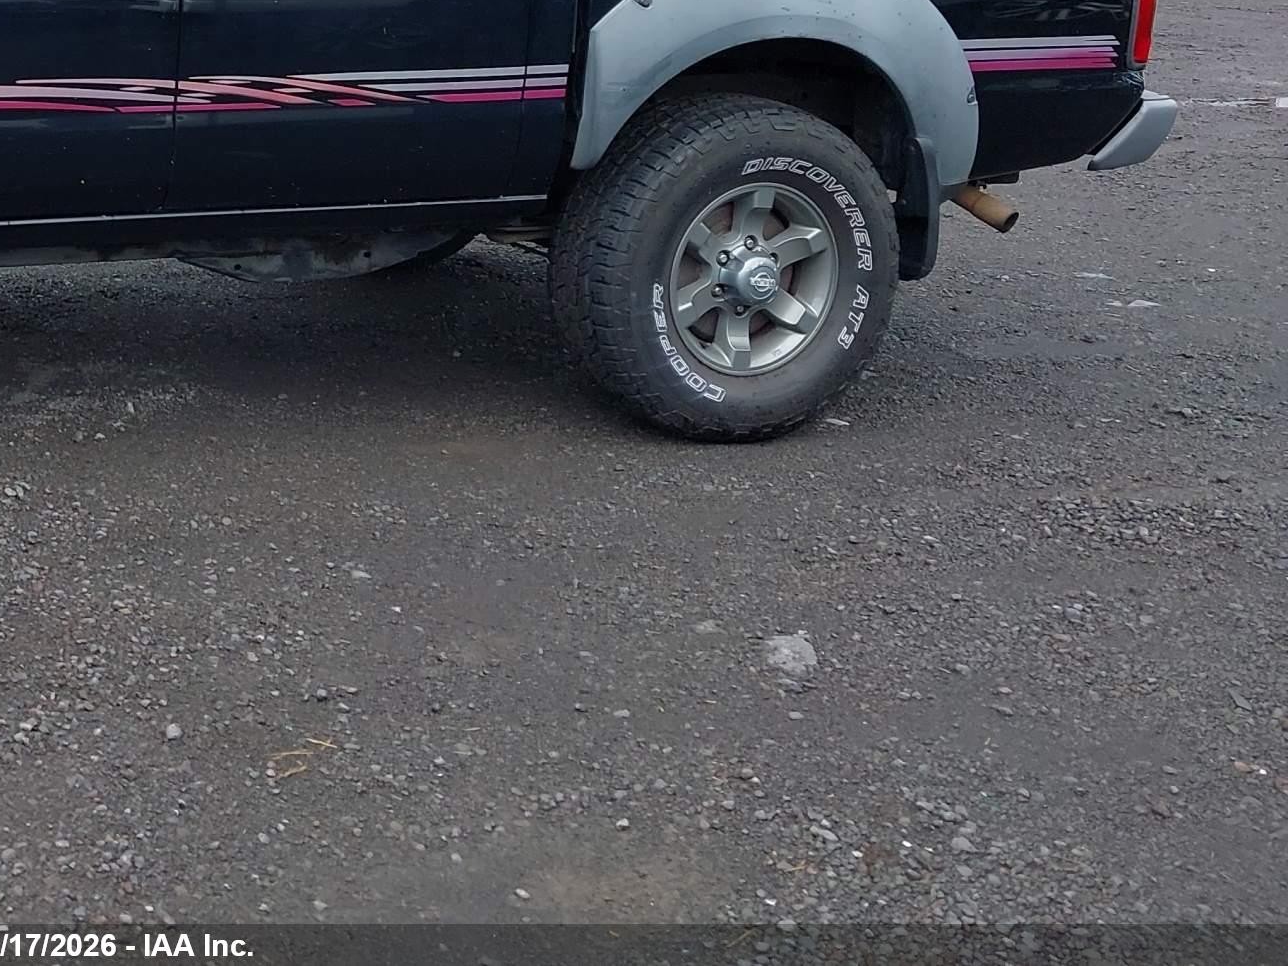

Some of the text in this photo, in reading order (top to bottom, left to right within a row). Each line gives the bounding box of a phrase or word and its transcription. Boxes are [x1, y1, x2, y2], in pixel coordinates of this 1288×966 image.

[741, 157, 873, 350] DISCOVERER AT3
[652, 282, 727, 403] COOPER
